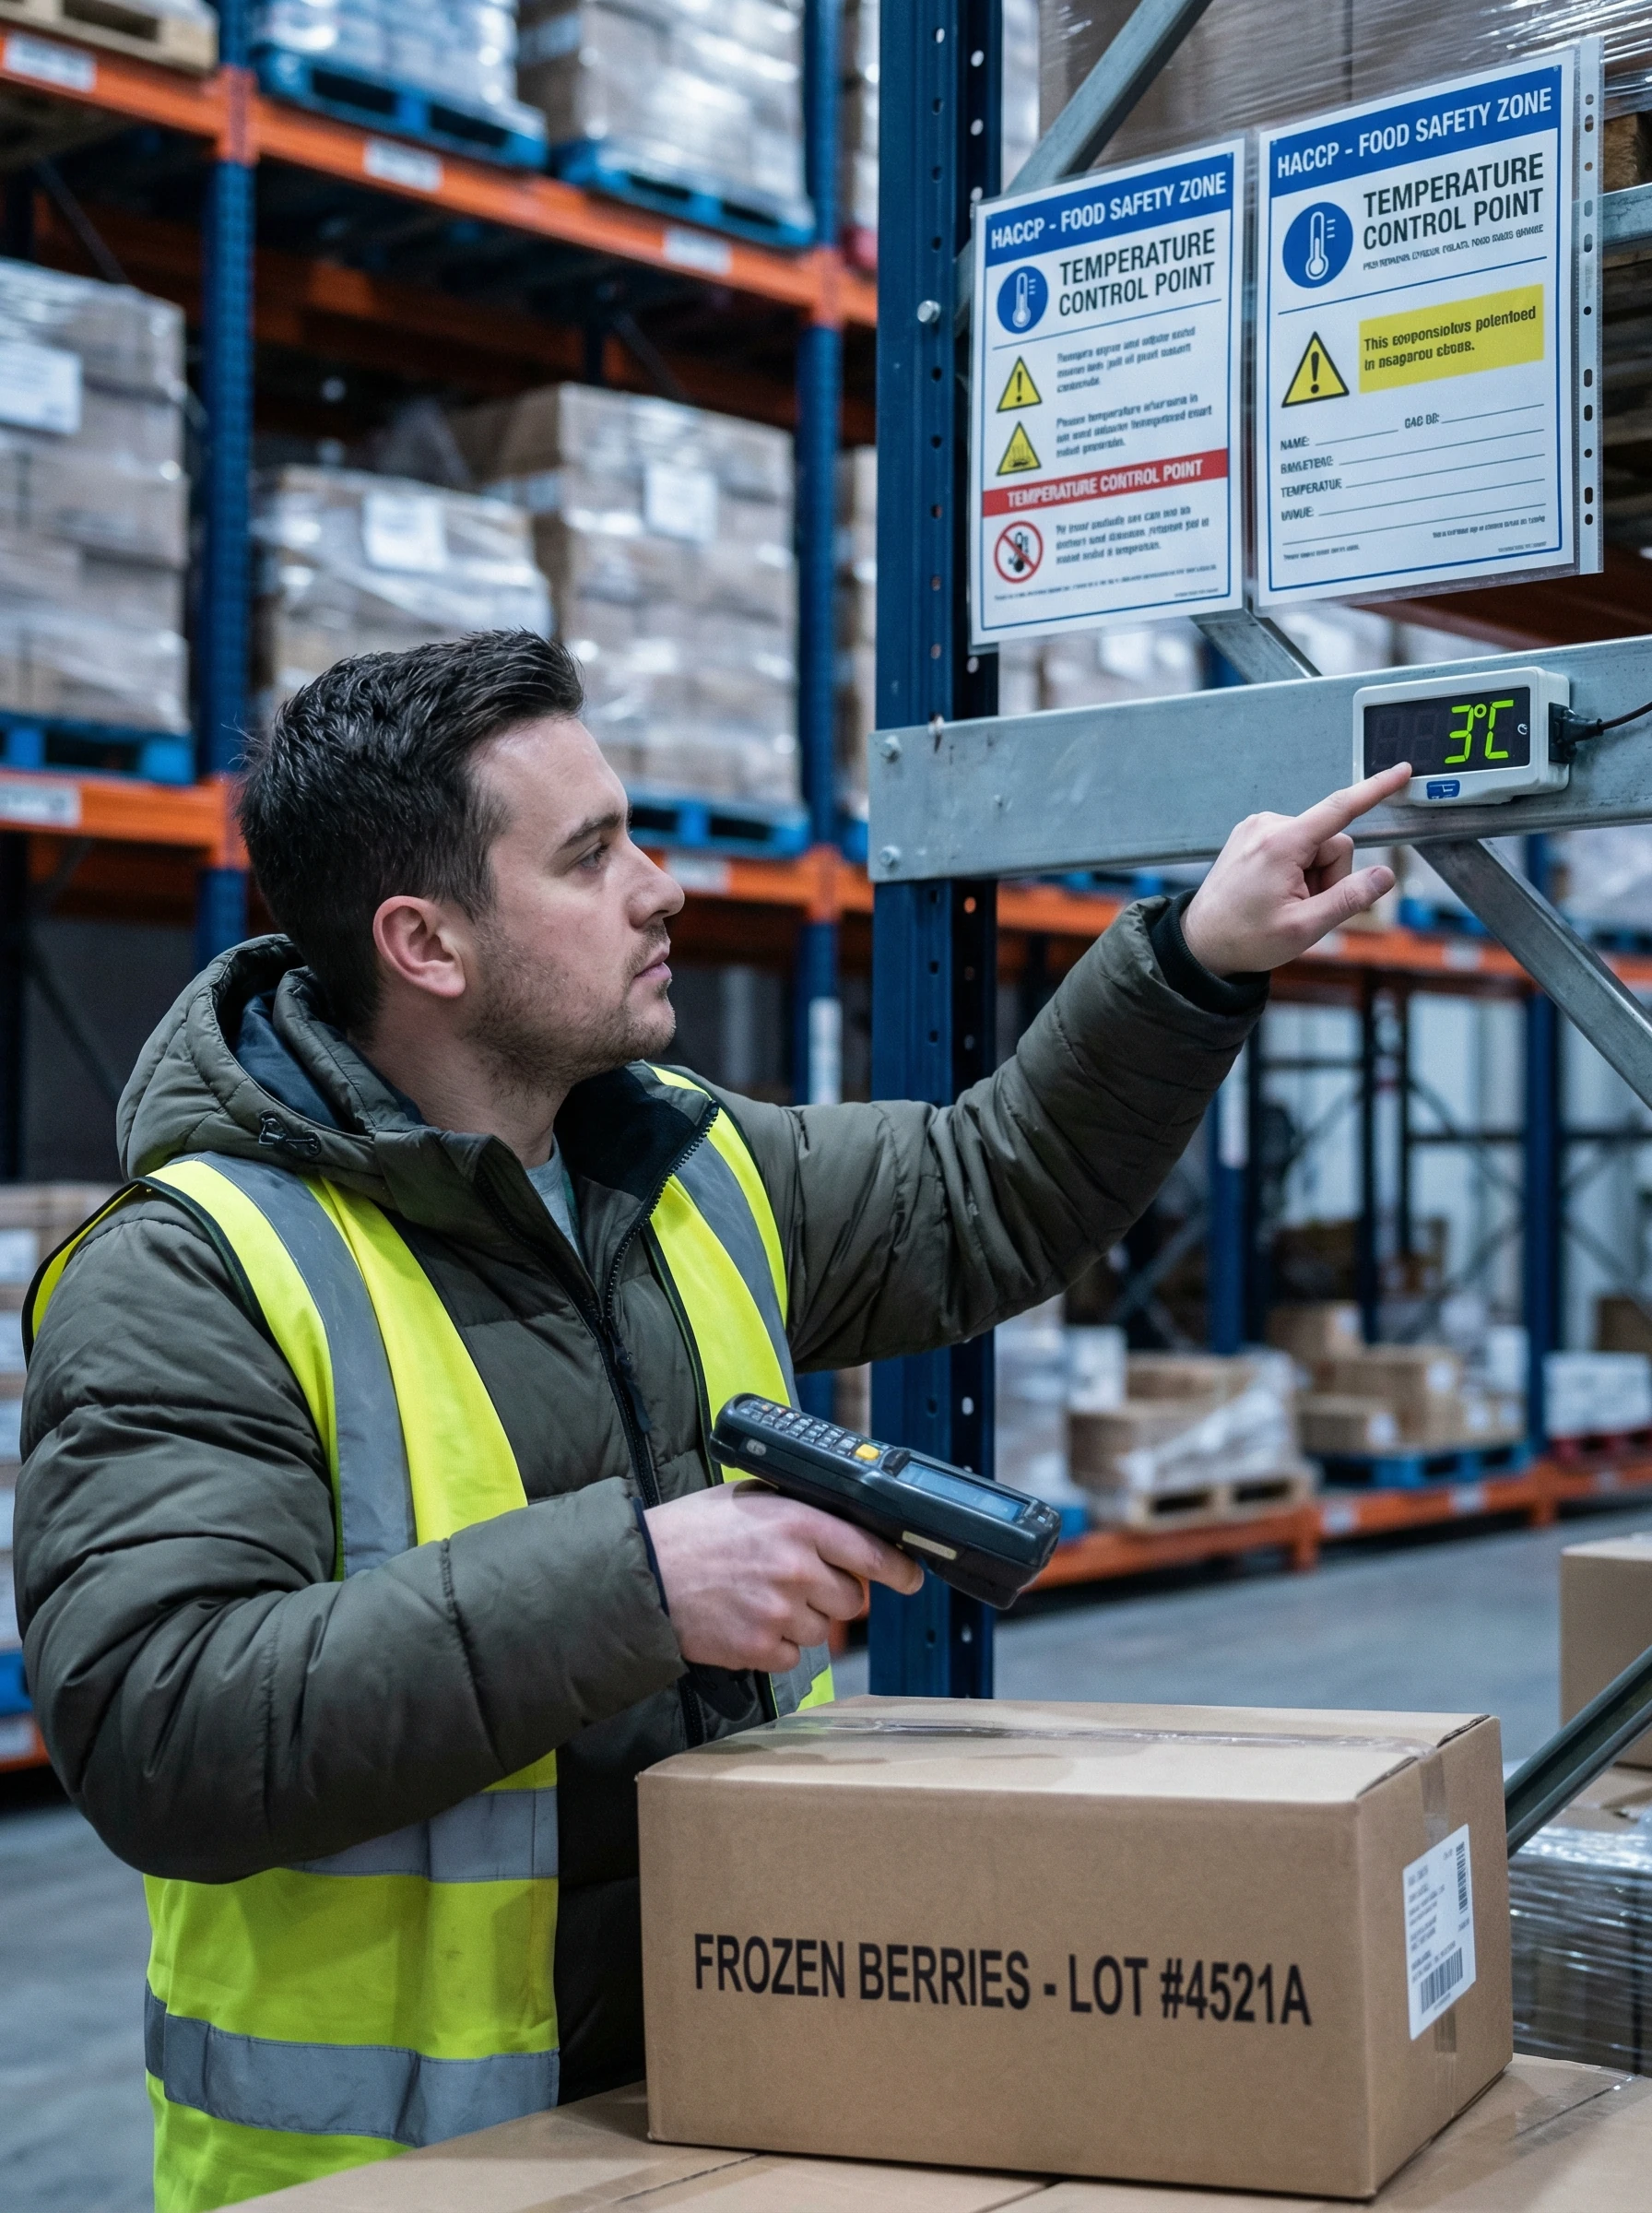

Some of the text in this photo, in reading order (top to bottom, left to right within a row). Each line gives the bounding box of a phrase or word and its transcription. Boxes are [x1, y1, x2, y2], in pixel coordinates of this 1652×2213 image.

[1278, 141, 1339, 179] HACCP
[1359, 123, 1410, 158] FOOD
[1415, 101, 1492, 143] SAFETY
[1497, 87, 1552, 124] ZONE
[991, 218, 1044, 250] HACCP
[1061, 203, 1105, 232] FOOD
[1110, 183, 1174, 220] SAFETY
[1179, 172, 1226, 204] ZONE
[1363, 152, 1543, 218] TEMPERATURE
[1363, 206, 1467, 250] CONTROL
[1474, 187, 1543, 226] POINT
[1059, 228, 1215, 286] TEMPERATURE
[1059, 262, 1215, 317] CONTROL POINT
[1364, 336, 1388, 351] This
[1007, 459, 1203, 508] TEMPERATURE CONTROL POINT
[694, 1933, 1313, 2027] FROZEN BERRIES - LOT #4521A
